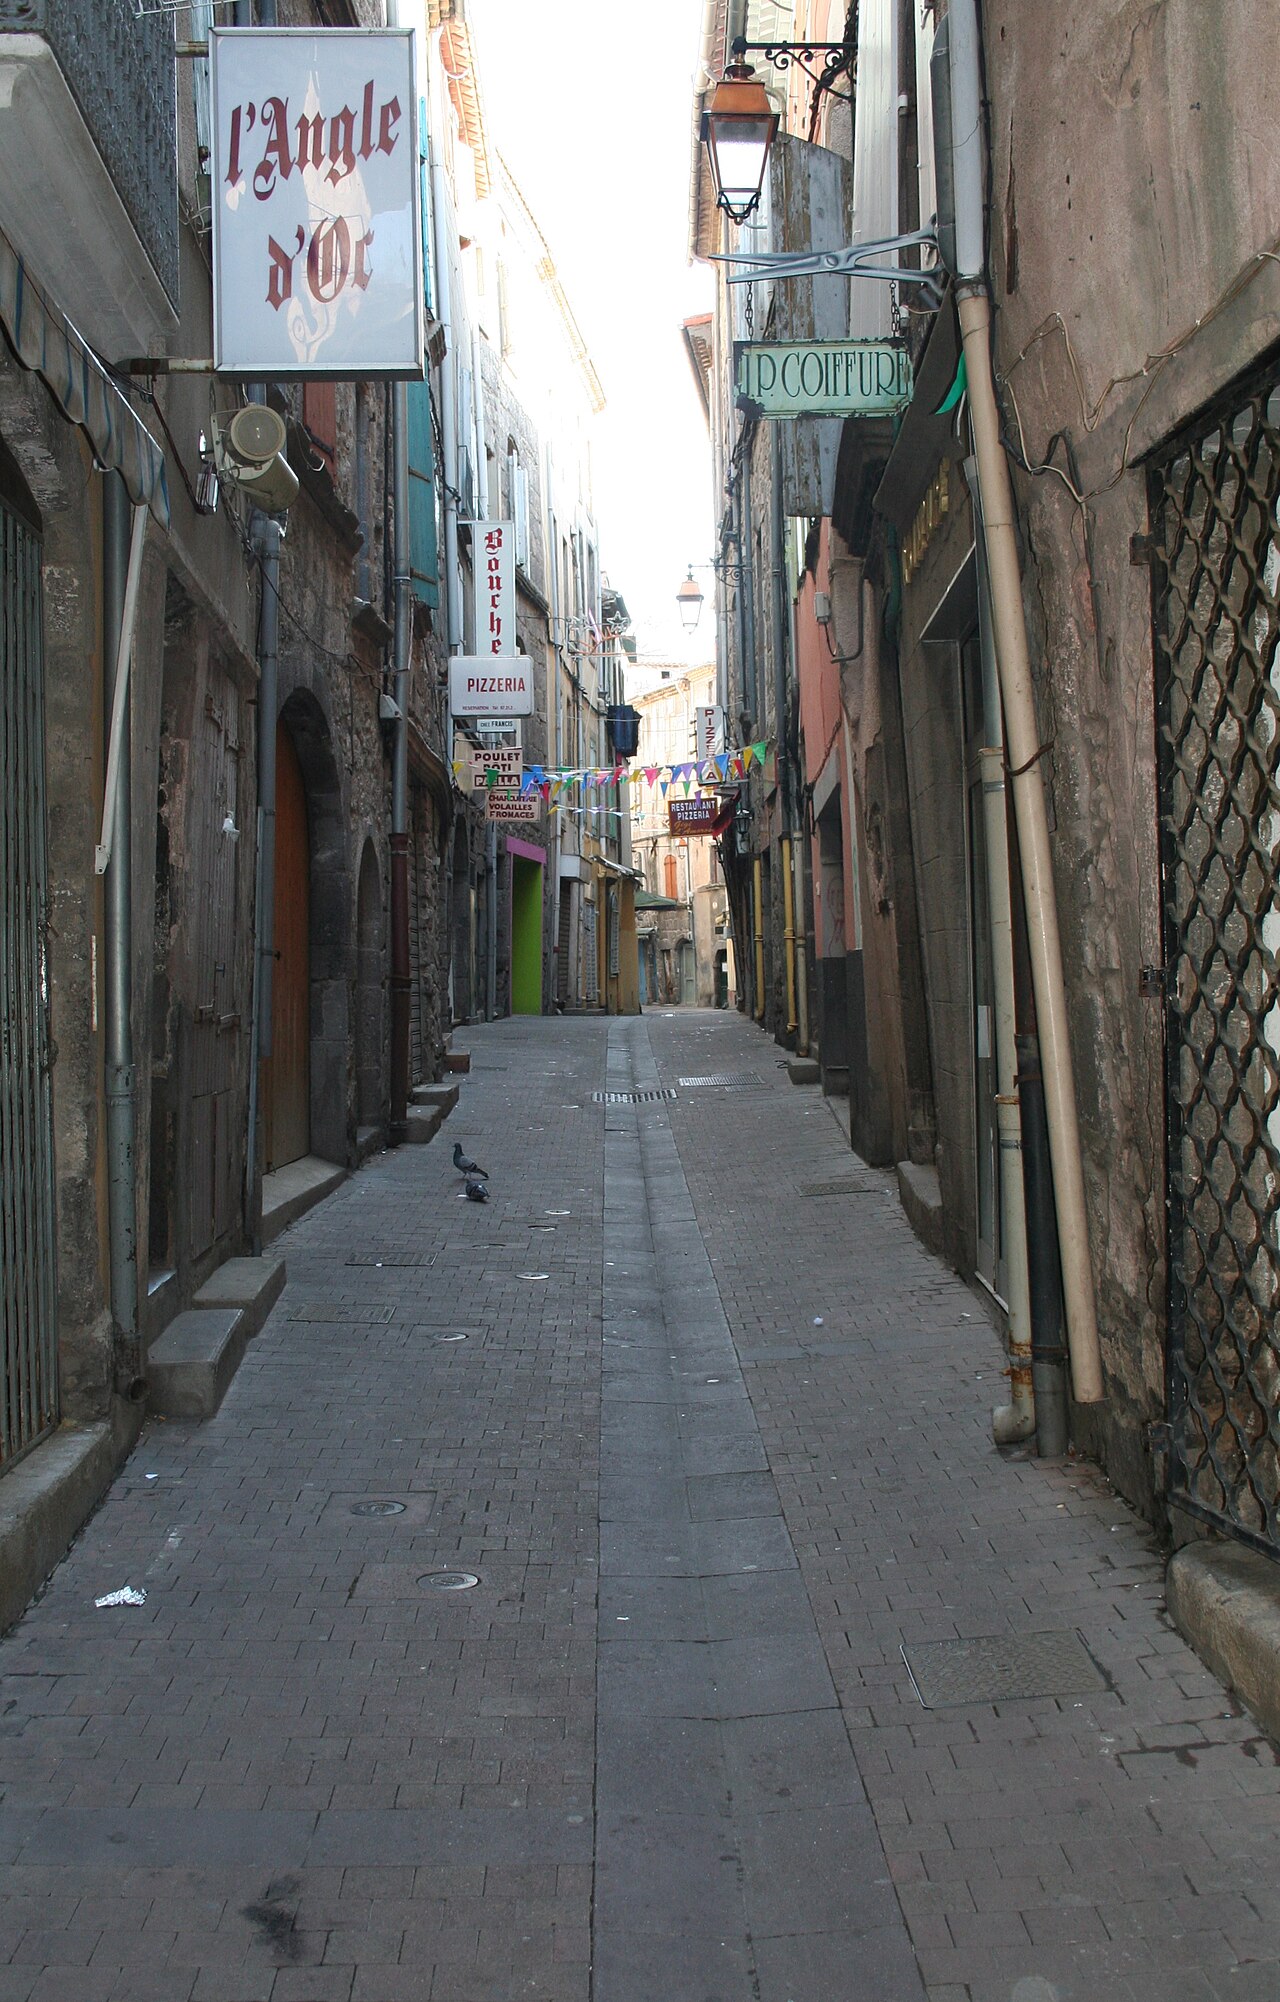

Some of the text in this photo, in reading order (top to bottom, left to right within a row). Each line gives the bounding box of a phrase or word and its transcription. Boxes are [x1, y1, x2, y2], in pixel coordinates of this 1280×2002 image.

[224, 79, 402, 201] l'Angle
[781, 350, 909, 398] COIFFURE
[484, 527, 503, 655] Bouche
[467, 677, 526, 693] PIZZERIA
[474, 752, 521, 762] POULET
[488, 803, 533, 811] VOLAILLES
[489, 810, 535, 819] FROMAGES
[677, 810, 710, 821] PIZZERIA
